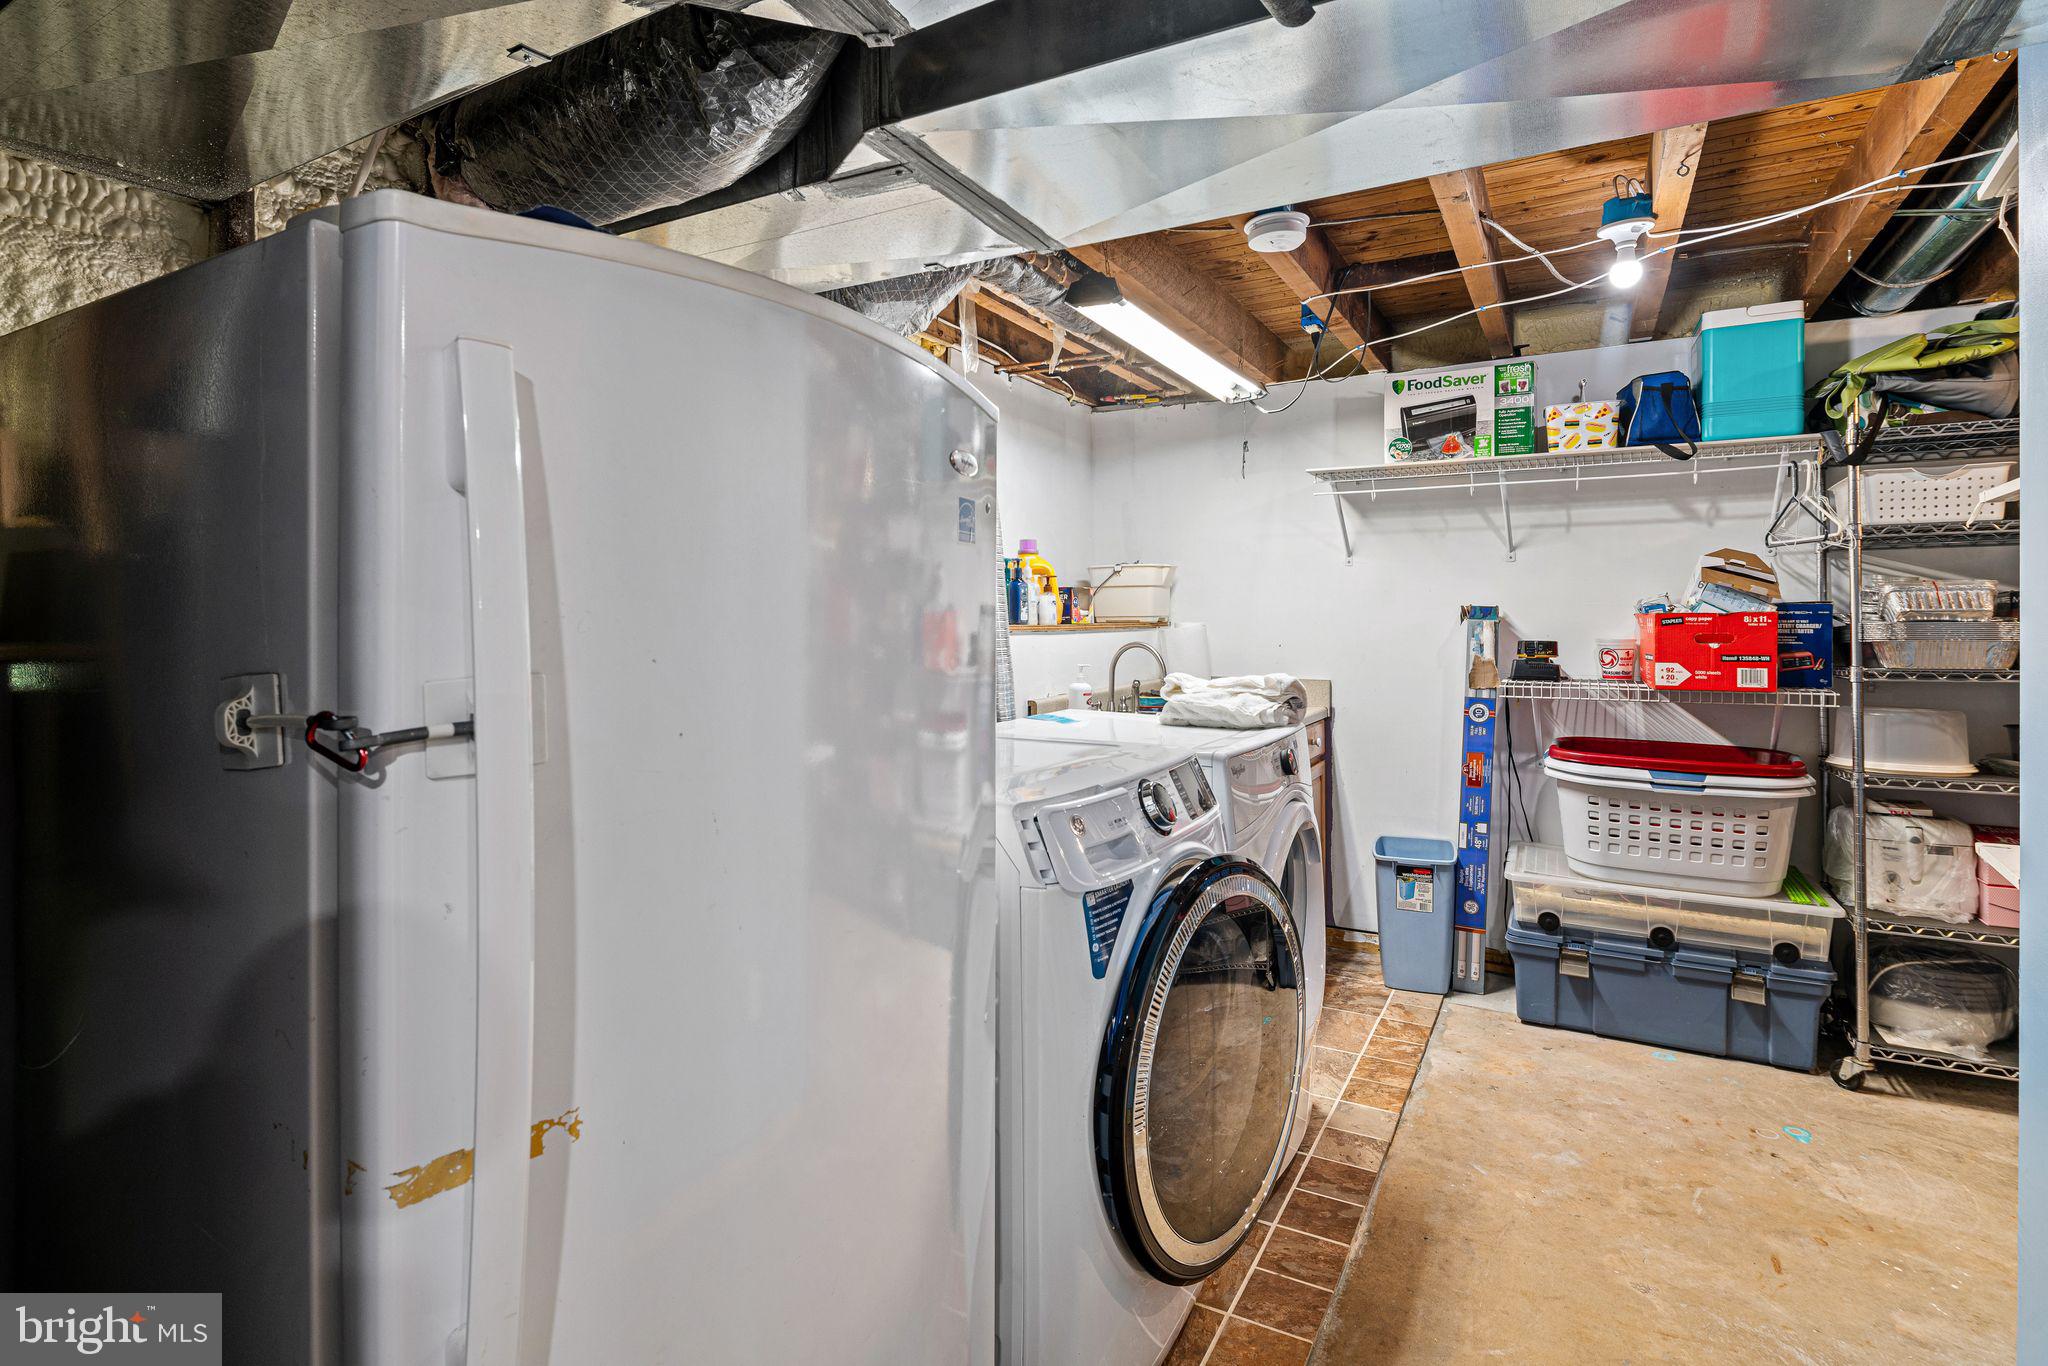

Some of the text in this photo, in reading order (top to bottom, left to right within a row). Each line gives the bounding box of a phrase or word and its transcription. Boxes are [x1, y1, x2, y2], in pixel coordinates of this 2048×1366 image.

[1507, 363, 1532, 374] fresh
[1407, 374, 1487, 391] FoodSaver
[1499, 396, 1530, 405] 3400
[1661, 617, 1683, 625] STAPLES
[1759, 615, 1767, 623] 11
[1474, 708, 1485, 718] 10
[1095, 886, 1114, 897] SMARTER
